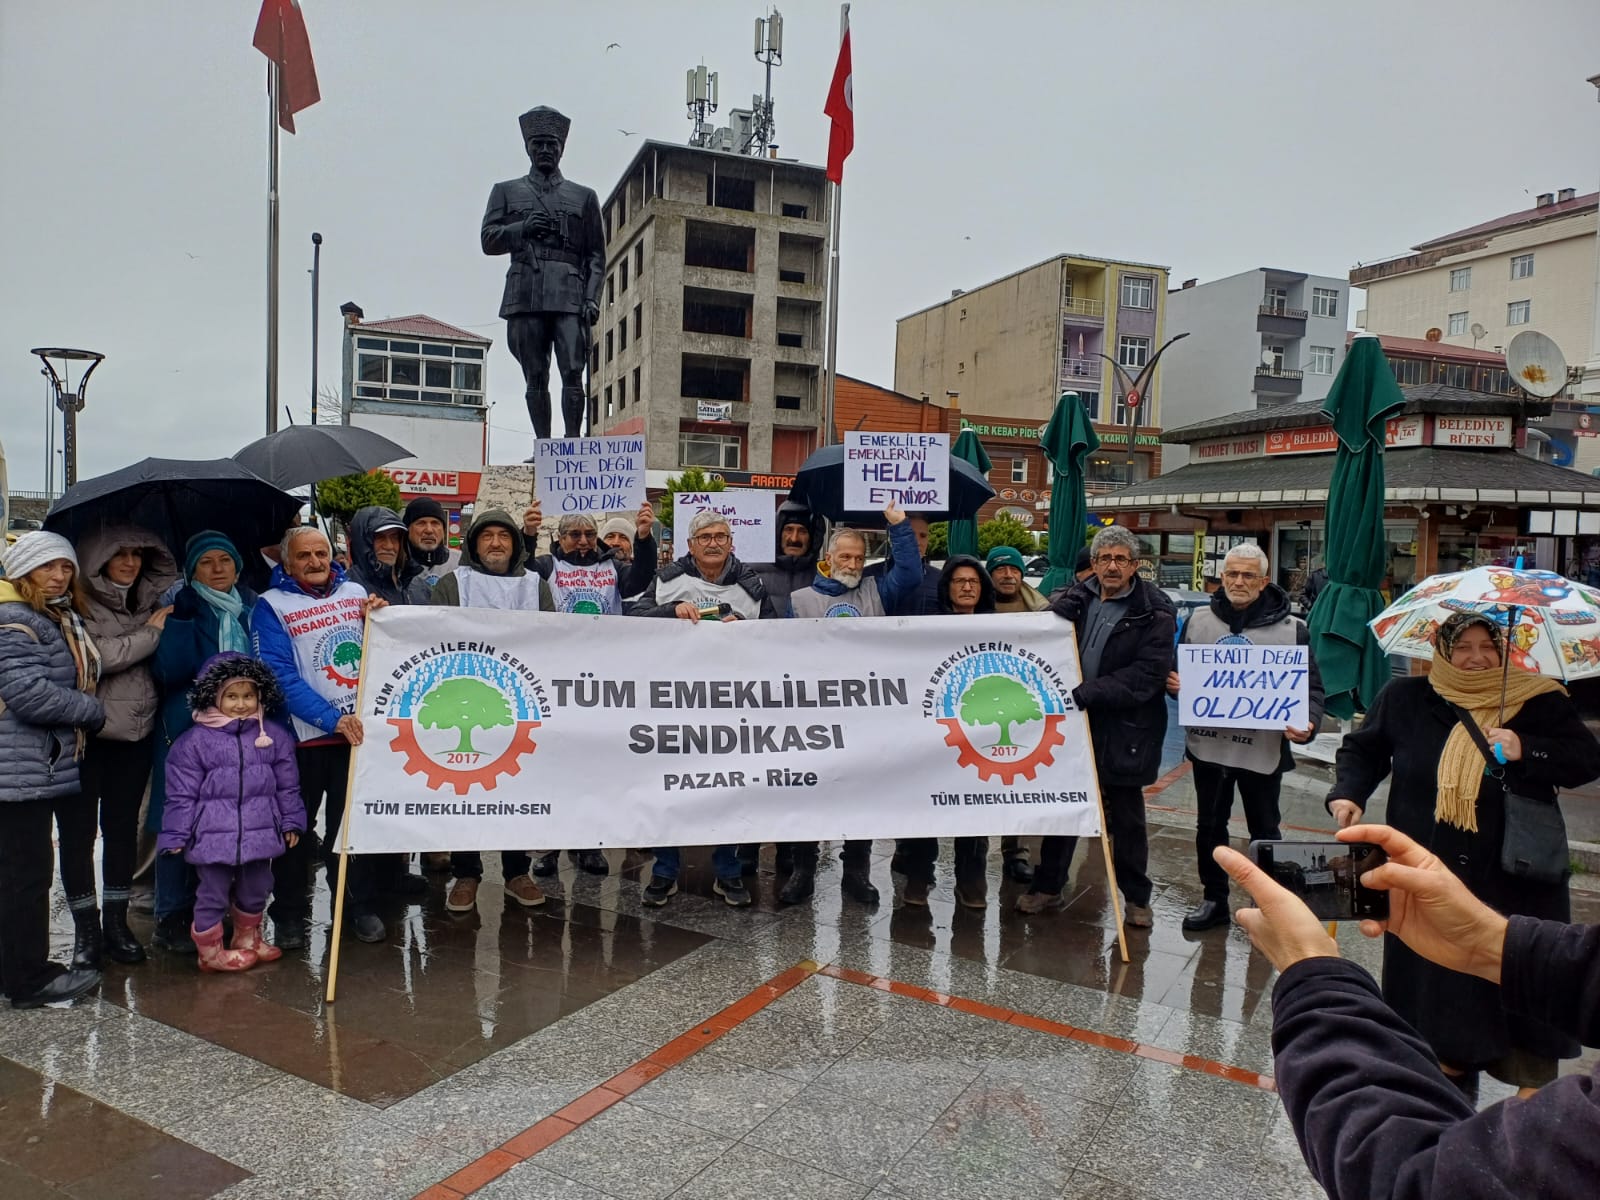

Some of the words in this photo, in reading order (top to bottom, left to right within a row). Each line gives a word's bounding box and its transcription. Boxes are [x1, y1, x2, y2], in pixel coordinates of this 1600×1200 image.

[991, 425, 1018, 437] KEBAP
[1020, 426, 1039, 438] PİDE
[1439, 418, 1505, 432] BELEDİYE
[860, 433, 942, 447] EMEKLİLER
[1293, 430, 1337, 445] BELEDİY
[1449, 432, 1496, 445] BÜFESİ
[607, 440, 643, 454] YUTUN
[848, 447, 927, 461] EMEKLERİNİ
[1232, 440, 1259, 455] TAKSİ
[556, 458, 590, 474] DİYE
[598, 456, 640, 472] DEĞİL
[862, 461, 936, 482] HELAL
[562, 493, 627, 511] ÖDEDİK
[679, 493, 712, 504] ZAM
[869, 486, 943, 505] ETMİYOR
[728, 518, 763, 526] ENCE
[1195, 535, 1205, 592] TAKS
[283, 602, 338, 625] DEMOKRATİK
[288, 615, 340, 638] İNSANCA
[1262, 648, 1308, 665] DEĞİL
[374, 683, 394, 716] TÜM
[392, 641, 496, 680] EMEKLİLERİN
[500, 652, 551, 718] SENDİKASI
[923, 688, 935, 718] TÜM
[929, 641, 1012, 685] EMEKLİLERİN
[1018, 648, 1074, 711] SENDİKASI
[1203, 669, 1307, 690] NAKAVT
[552, 672, 636, 708] TÜM
[649, 671, 909, 709] EMEKLİLERİN
[1192, 696, 1300, 721] OLDUK
[628, 718, 845, 755] SENDİKASI
[1190, 728, 1217, 738] PAZAR
[1232, 734, 1254, 745] RİZE
[447, 753, 481, 764] 2017
[991, 747, 1019, 757] 2017
[663, 771, 746, 791] PAZAR
[766, 768, 818, 787] Rize
[931, 791, 961, 806] TÜM
[964, 789, 1088, 805] EMEKLİLERİN-SEN
[364, 799, 400, 815] TÜM
[404, 800, 552, 816] EMEKLİLERİN-SEN
